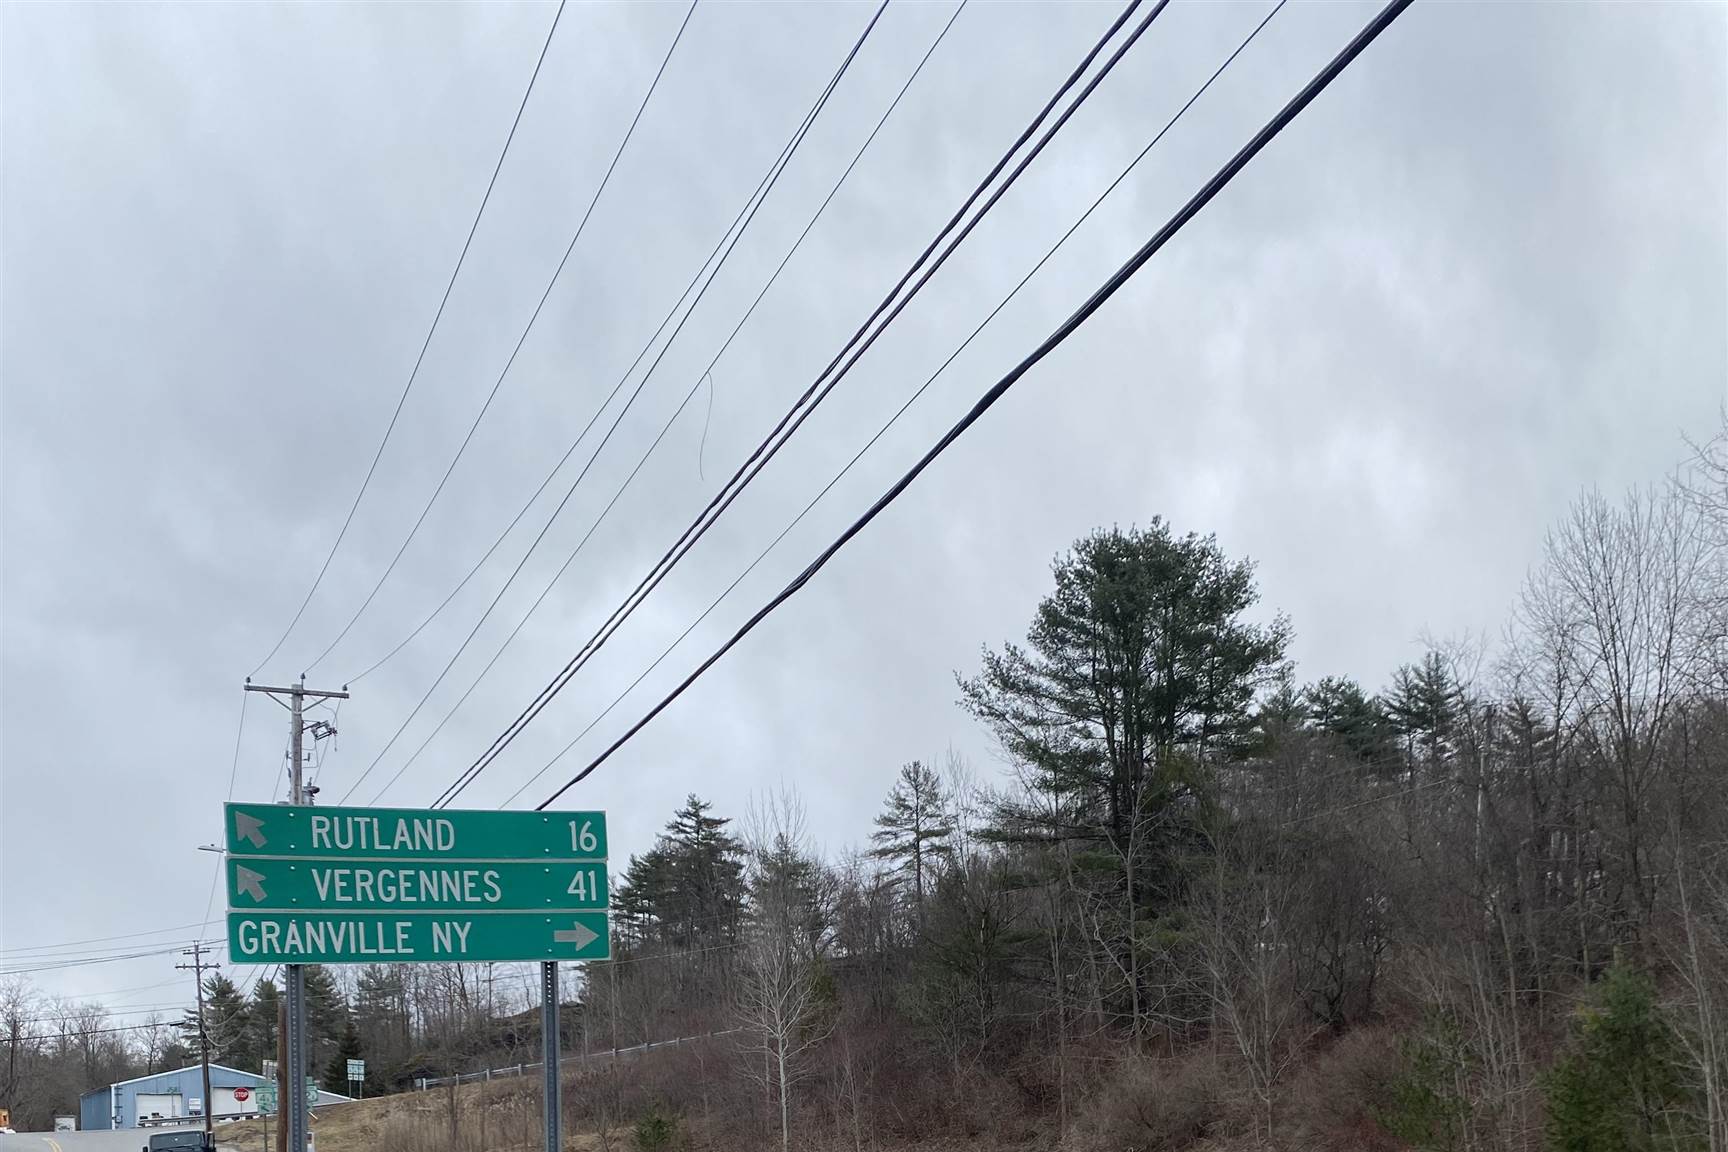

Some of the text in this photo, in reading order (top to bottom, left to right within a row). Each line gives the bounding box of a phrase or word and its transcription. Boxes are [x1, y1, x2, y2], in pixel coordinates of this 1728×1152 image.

[311, 816, 598, 852] RUTLAND 16
[312, 869, 597, 902] VERGENNES 41
[238, 920, 472, 955] GRANVILLE NY
